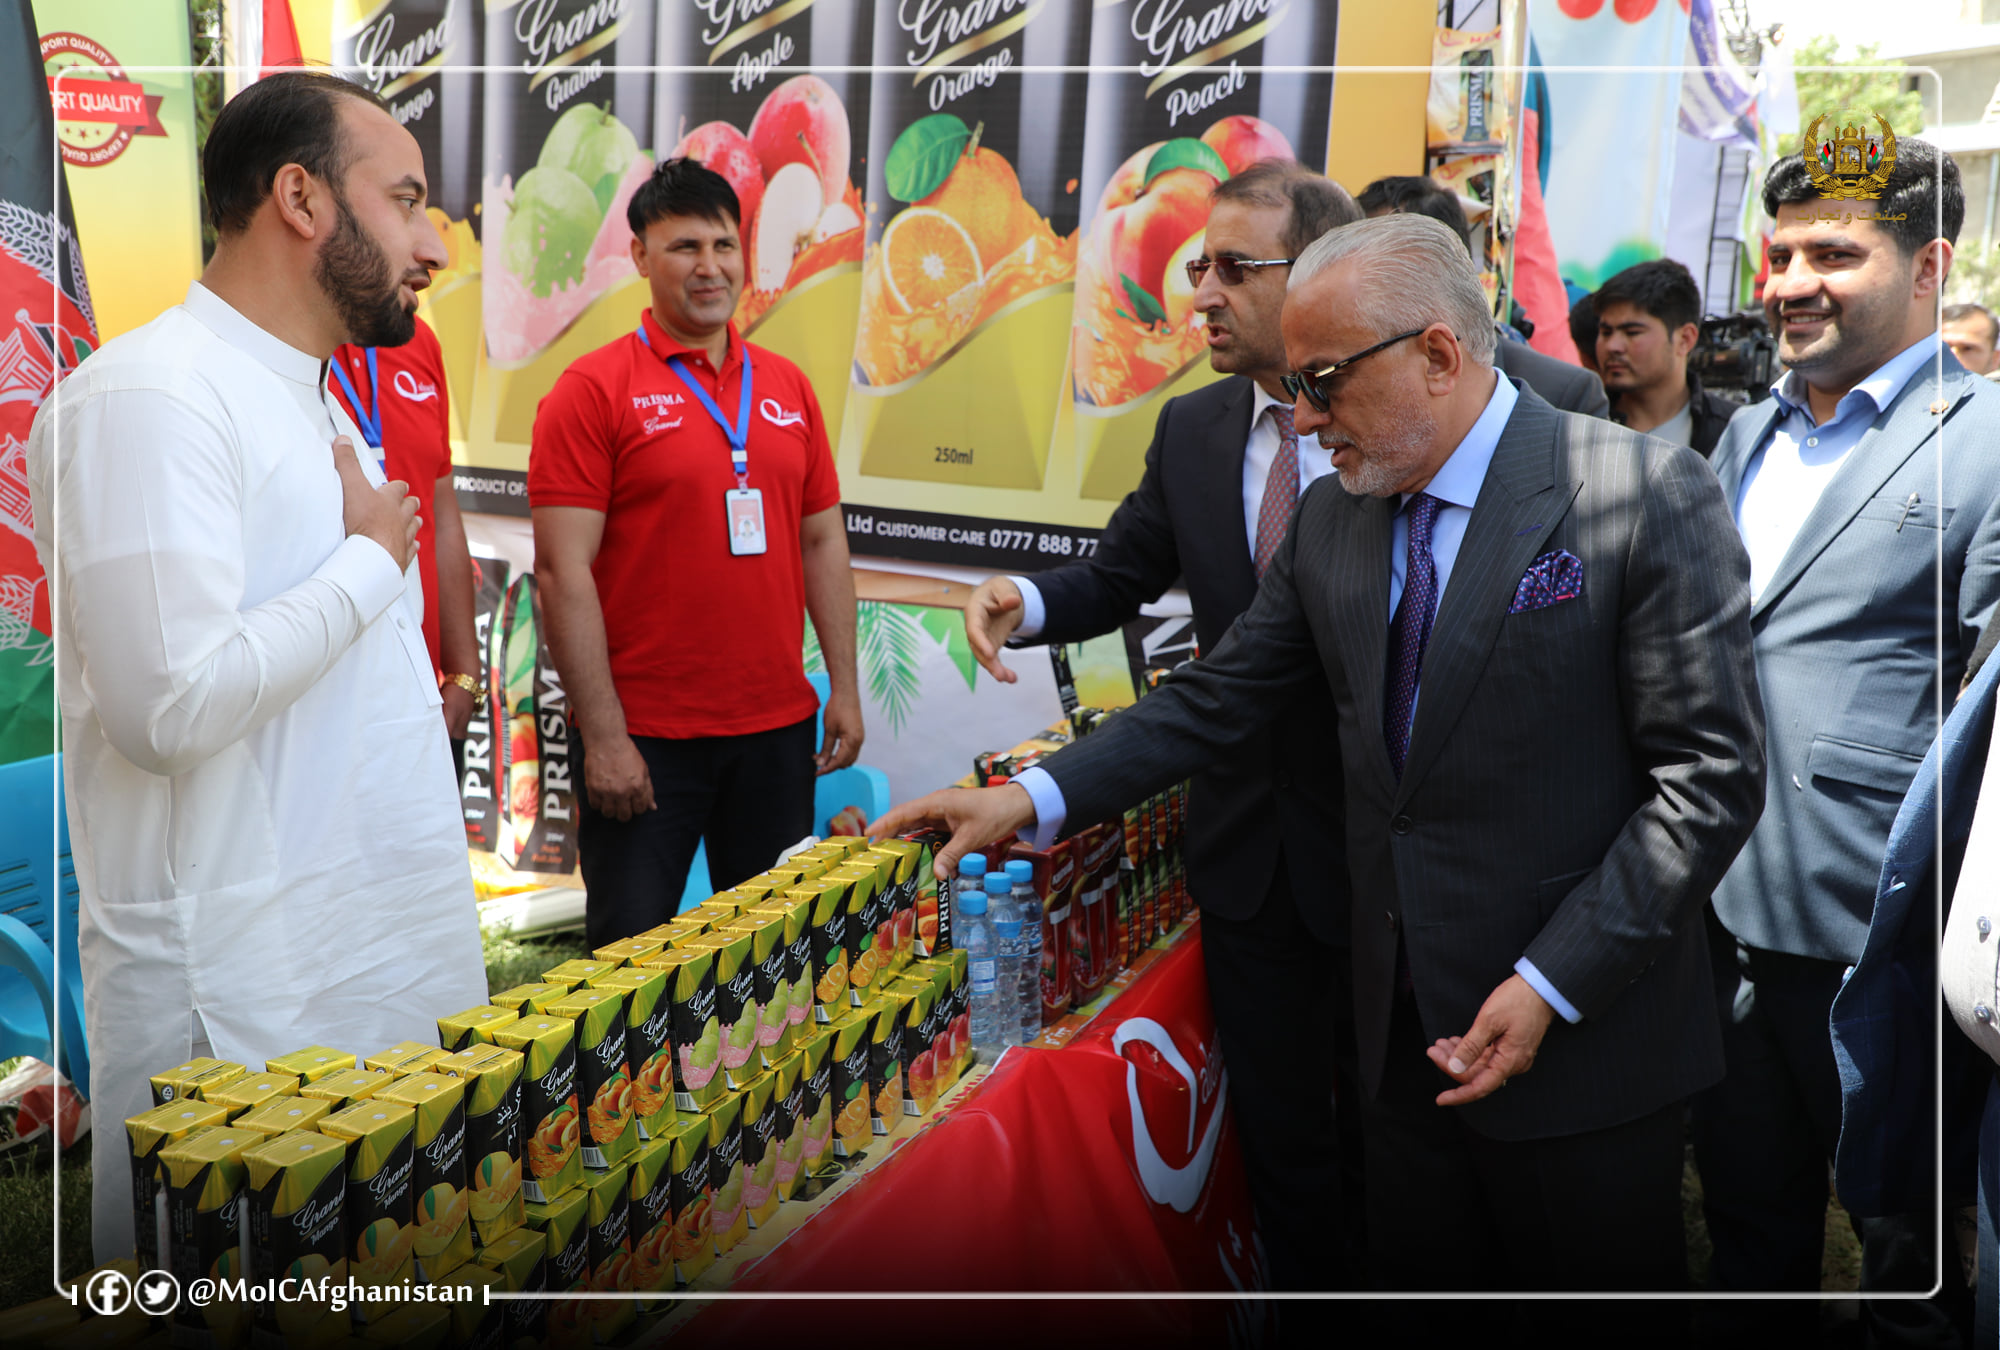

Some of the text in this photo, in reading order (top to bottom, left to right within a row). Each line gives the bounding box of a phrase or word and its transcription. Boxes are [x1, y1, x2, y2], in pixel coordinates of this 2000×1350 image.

[70, 37, 112, 65] QUALITY
[355, 2, 455, 93] Grand
[731, 33, 795, 93] Apple
[546, 59, 603, 111] Guava
[929, 48, 1014, 111] Orange
[1166, 59, 1247, 127] Peach
[79, 92, 142, 113] QUALITY
[391, 88, 434, 126] ango
[632, 393, 686, 409] PRISMA
[658, 404, 669, 416] &
[934, 447, 974, 465] 250ml
[453, 476, 507, 494] PRODUCT
[847, 514, 873, 534] Ltd
[876, 521, 946, 542] CUSTOMER
[948, 528, 986, 546] CARE
[989, 528, 1034, 550] 0777
[1038, 534, 1072, 555] 888
[538, 662, 572, 821] PRISM
[441, 1148, 463, 1175] Mango
[292, 1174, 346, 1236] Grand
[384, 1181, 409, 1210] Mango
[311, 1216, 339, 1247] Mango
